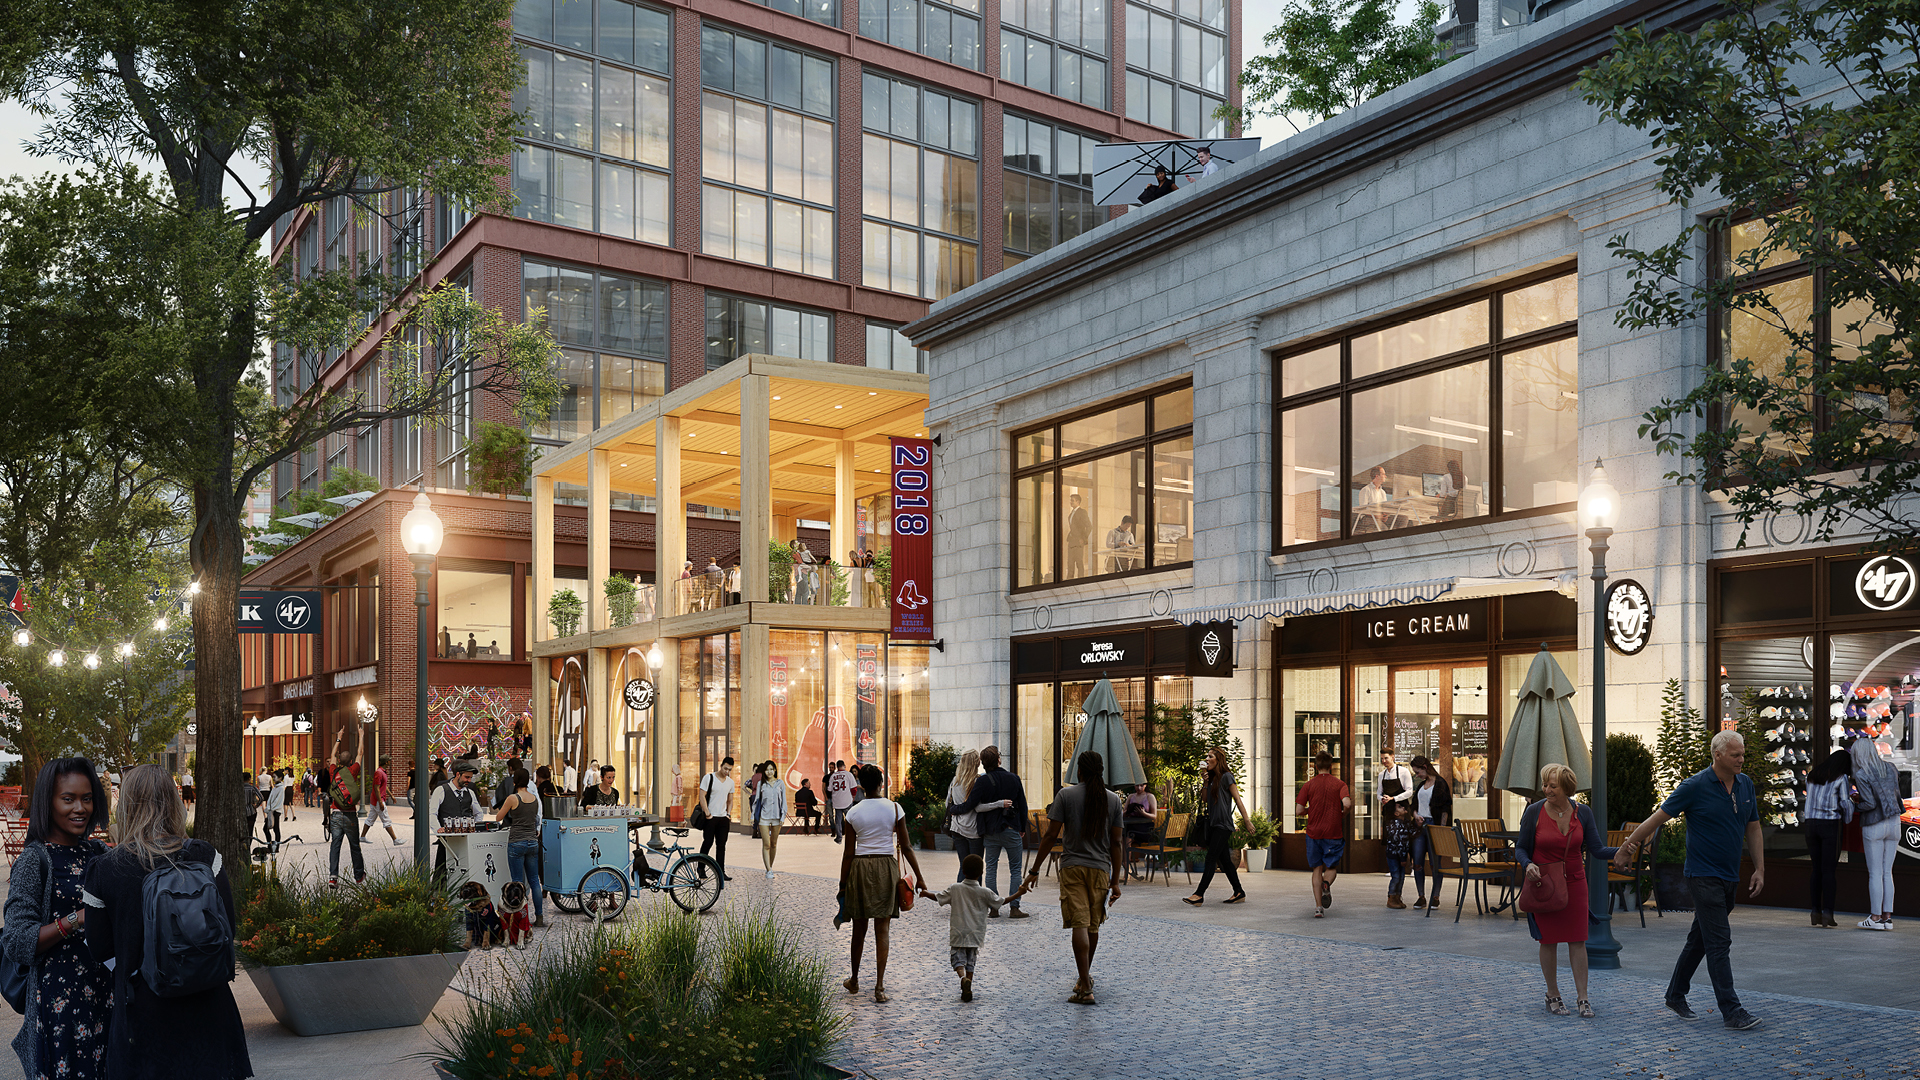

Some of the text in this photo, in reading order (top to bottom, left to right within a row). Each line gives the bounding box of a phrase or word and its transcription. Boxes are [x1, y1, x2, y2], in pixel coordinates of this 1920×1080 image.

[895, 445, 928, 536] 2018
[1368, 613, 1469, 638] ICE CREAM
[1081, 650, 1125, 664] ORLOWSKY
[1091, 642, 1114, 652] Teresa
[770, 660, 787, 706] 1918
[857, 649, 876, 705] 1967
[283, 681, 299, 700] BAKERY
[832, 780, 847, 792] 34
